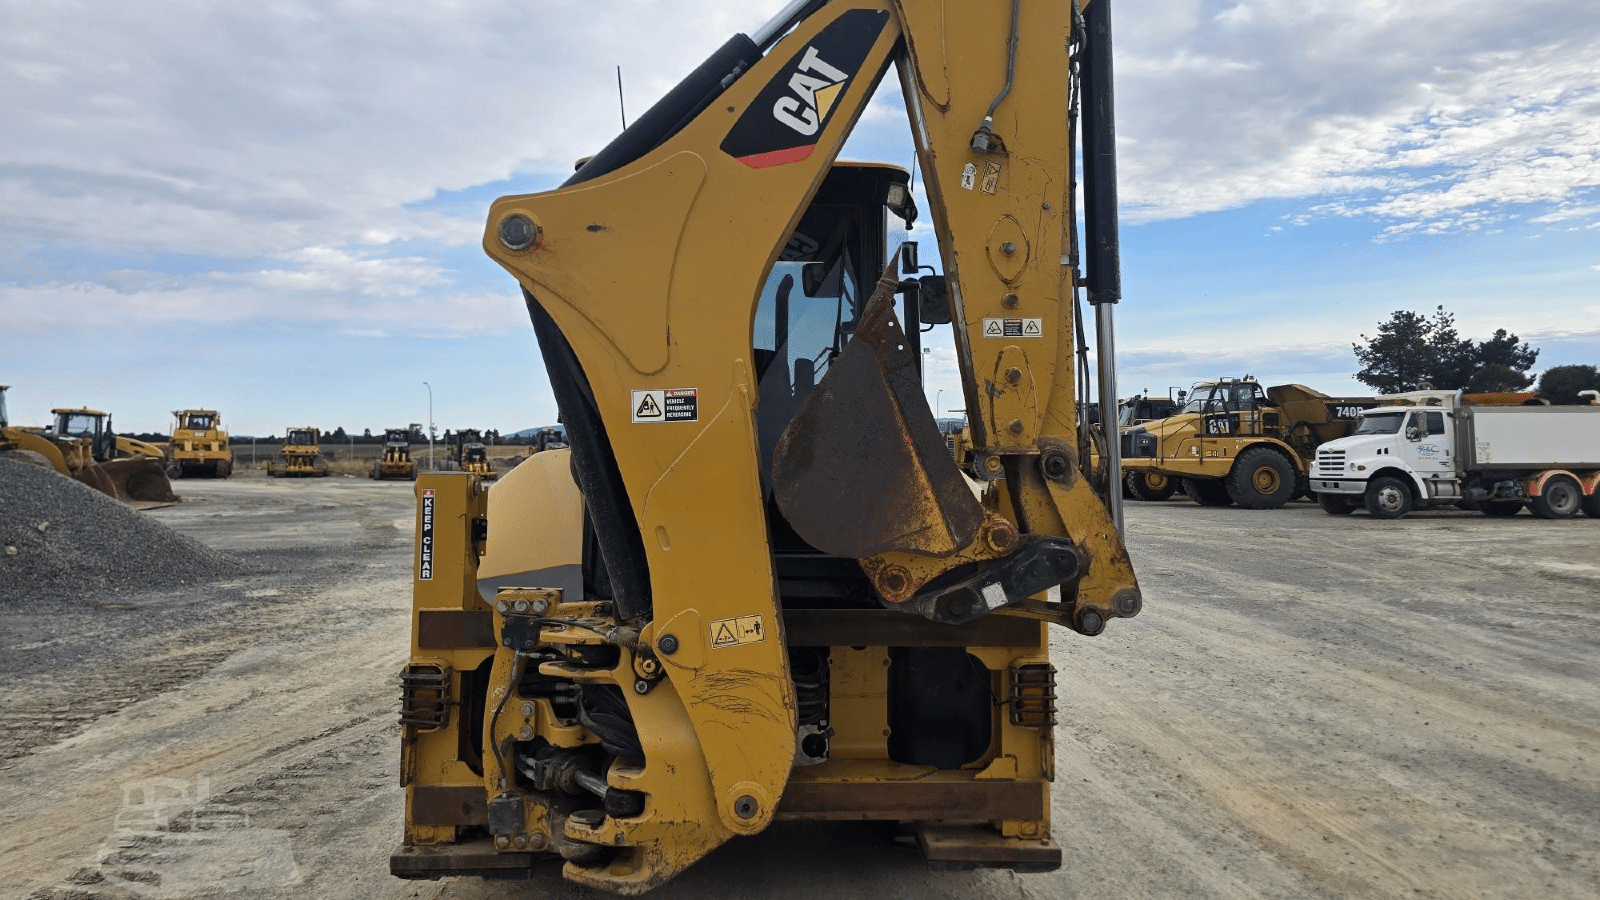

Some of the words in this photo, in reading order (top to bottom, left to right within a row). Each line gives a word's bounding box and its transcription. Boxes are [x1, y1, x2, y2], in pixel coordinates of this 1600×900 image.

[773, 46, 848, 136] CAT
[424, 498, 432, 531] KEEP
[422, 536, 431, 578] CLEAR
